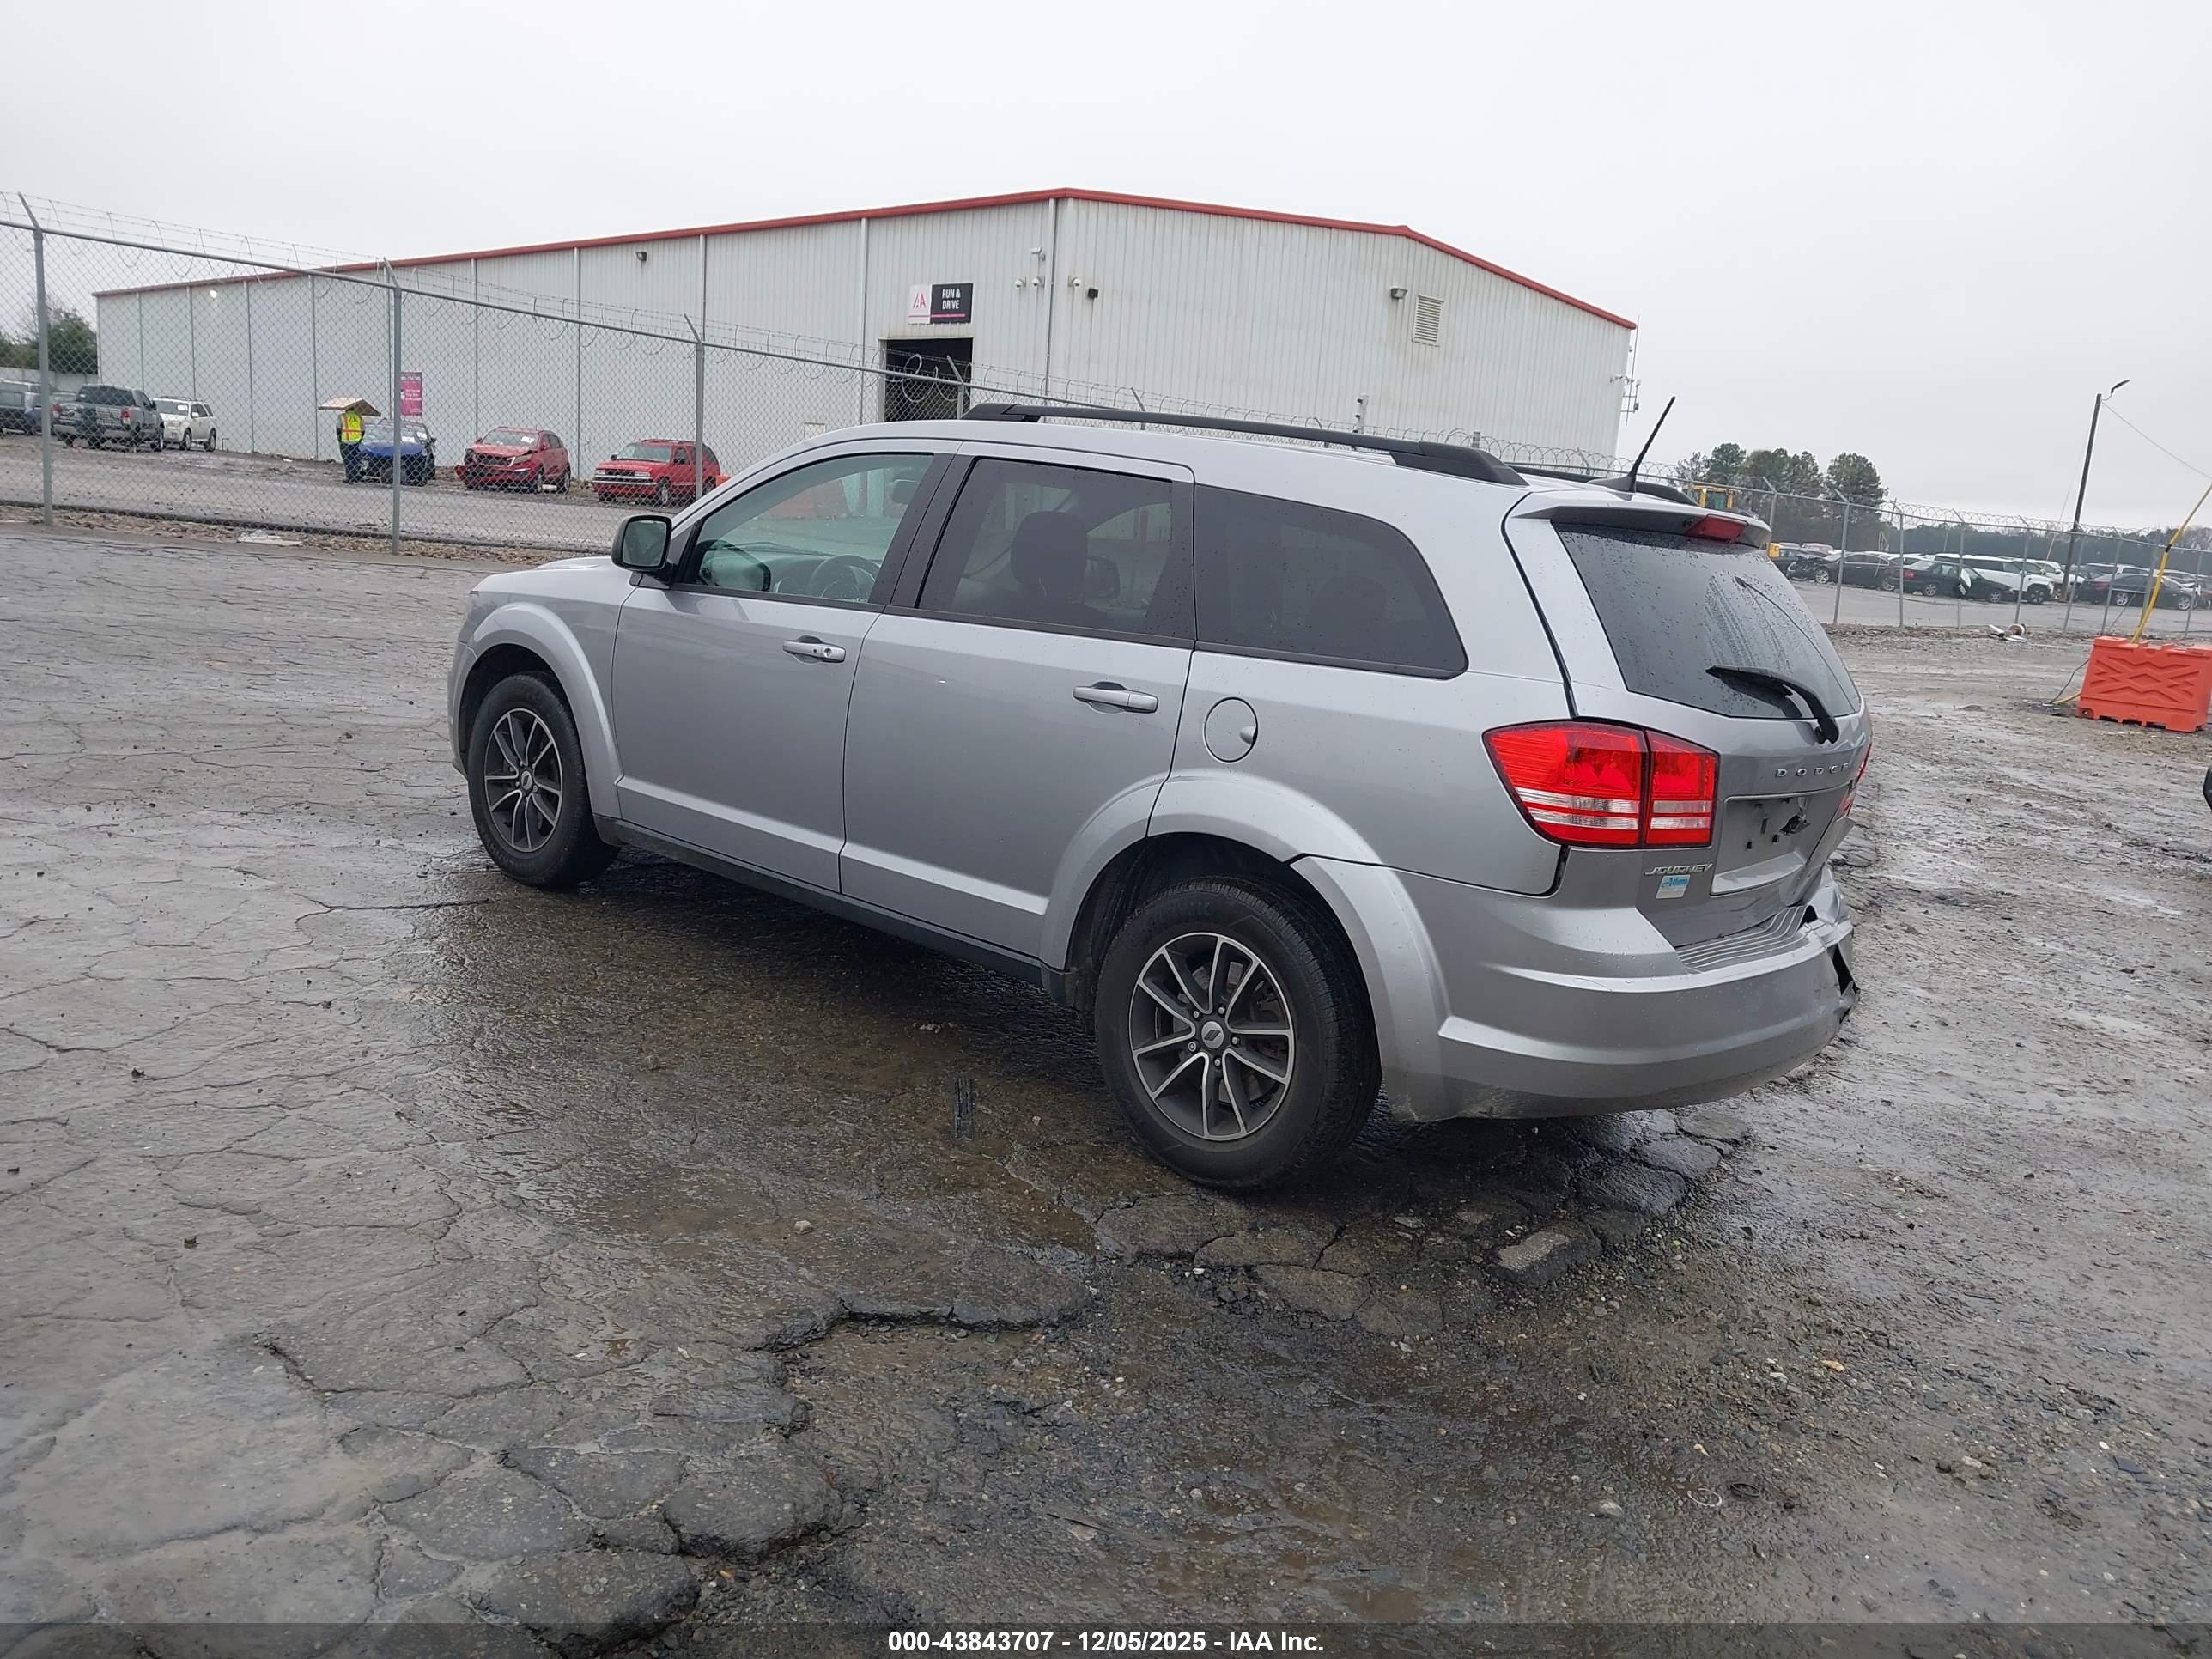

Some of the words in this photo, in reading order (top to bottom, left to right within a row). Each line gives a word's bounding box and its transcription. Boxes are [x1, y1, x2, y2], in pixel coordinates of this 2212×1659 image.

[942, 288, 955, 299] RUN
[956, 288, 961, 298] &
[942, 300, 960, 310] DRIVE
[1776, 763, 1849, 777] DODGE
[1644, 863, 1713, 875] JOURNEY
